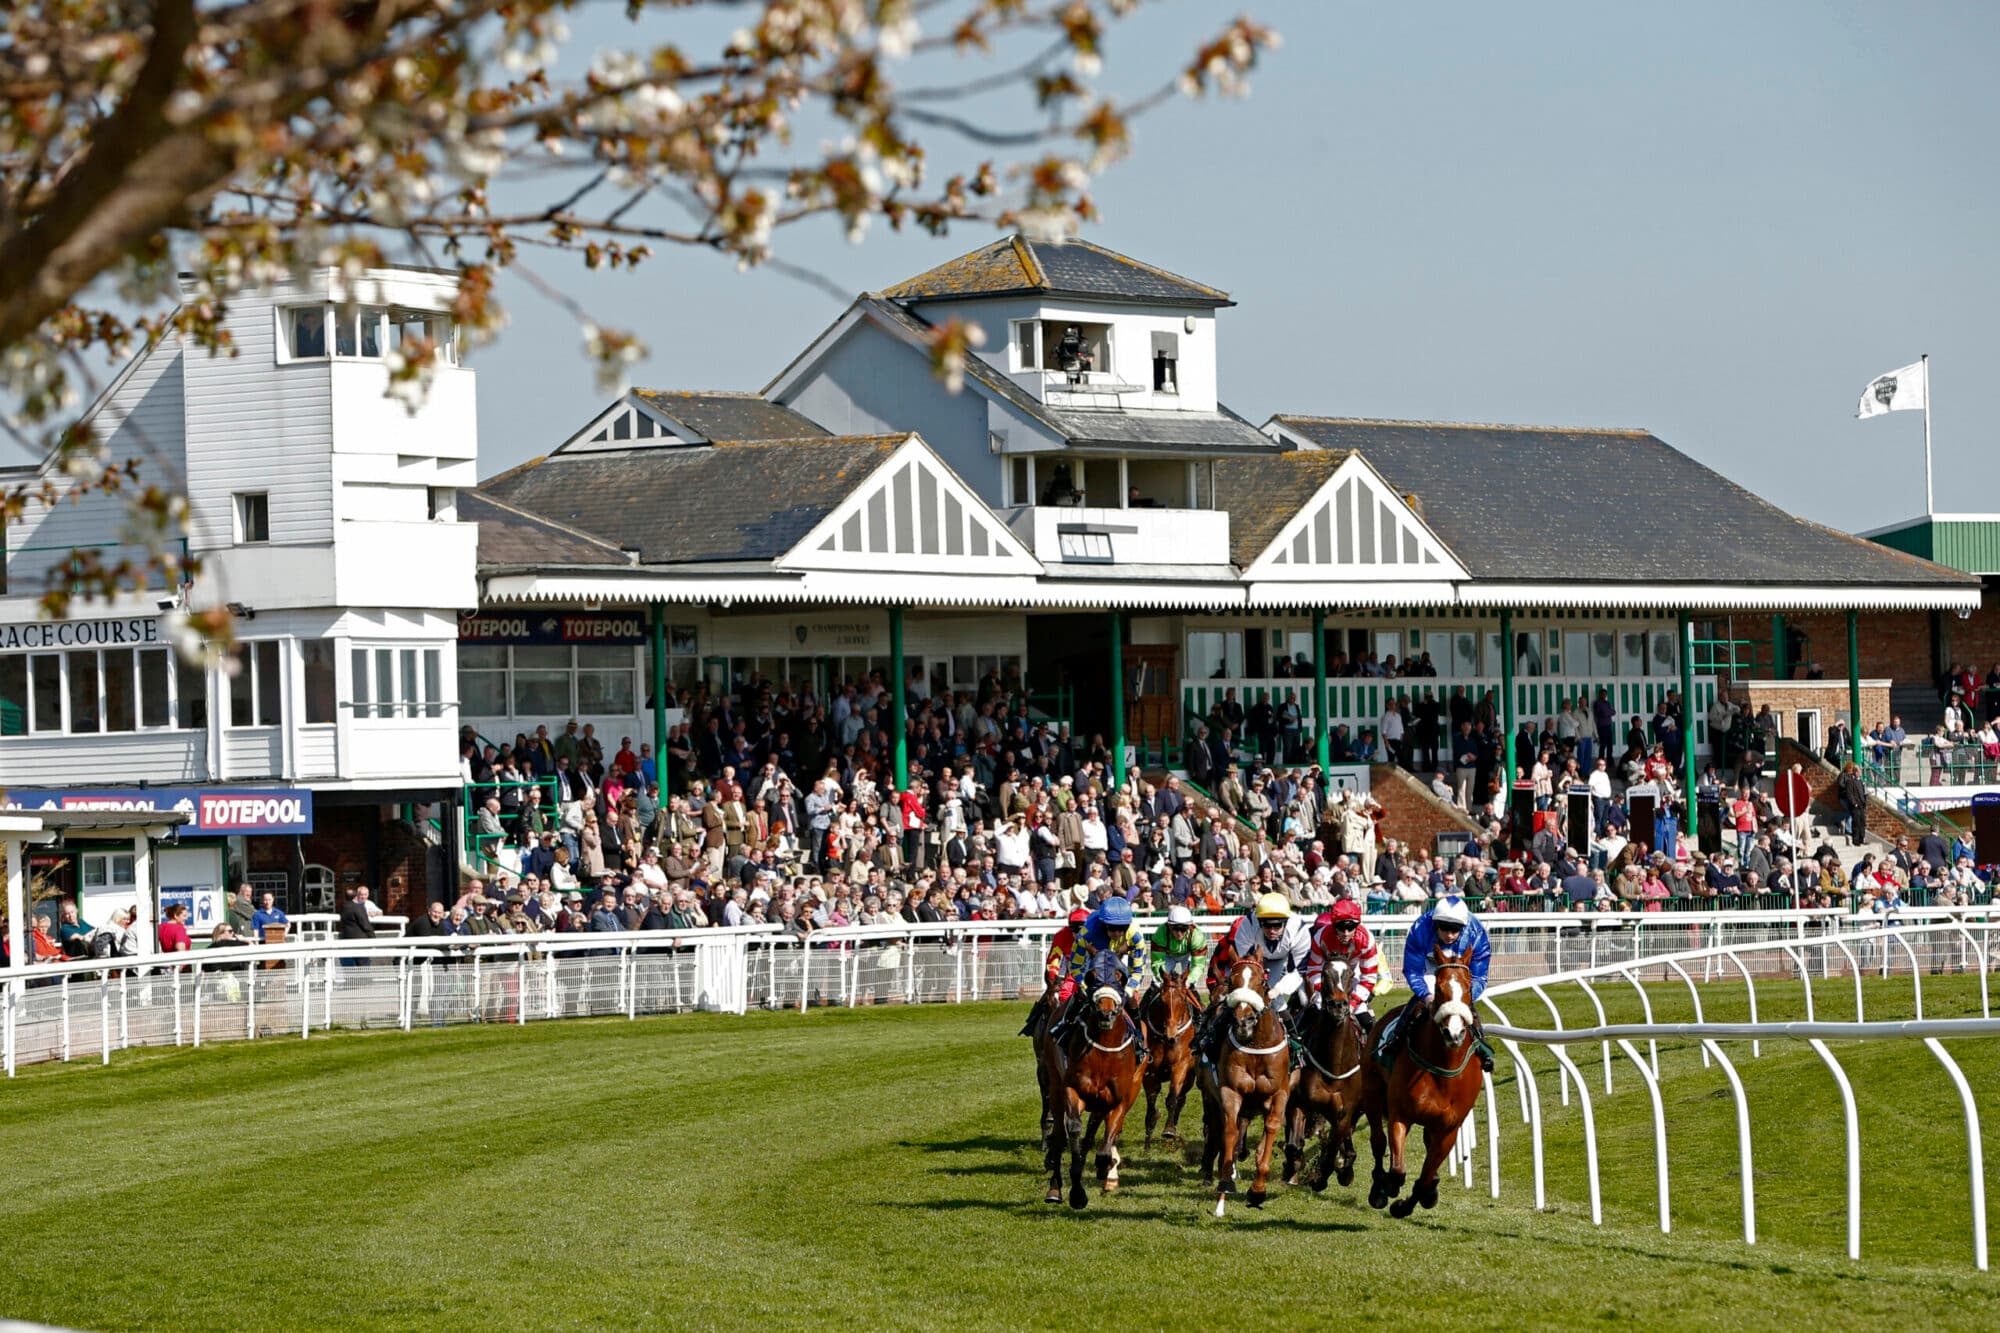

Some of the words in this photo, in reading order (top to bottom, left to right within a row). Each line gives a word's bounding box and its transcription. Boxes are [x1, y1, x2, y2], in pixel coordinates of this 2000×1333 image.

[458, 619, 530, 637] OTEPOOL
[565, 619, 642, 637] TOTEPOOL
[203, 799, 306, 824] TOTEPOOL
